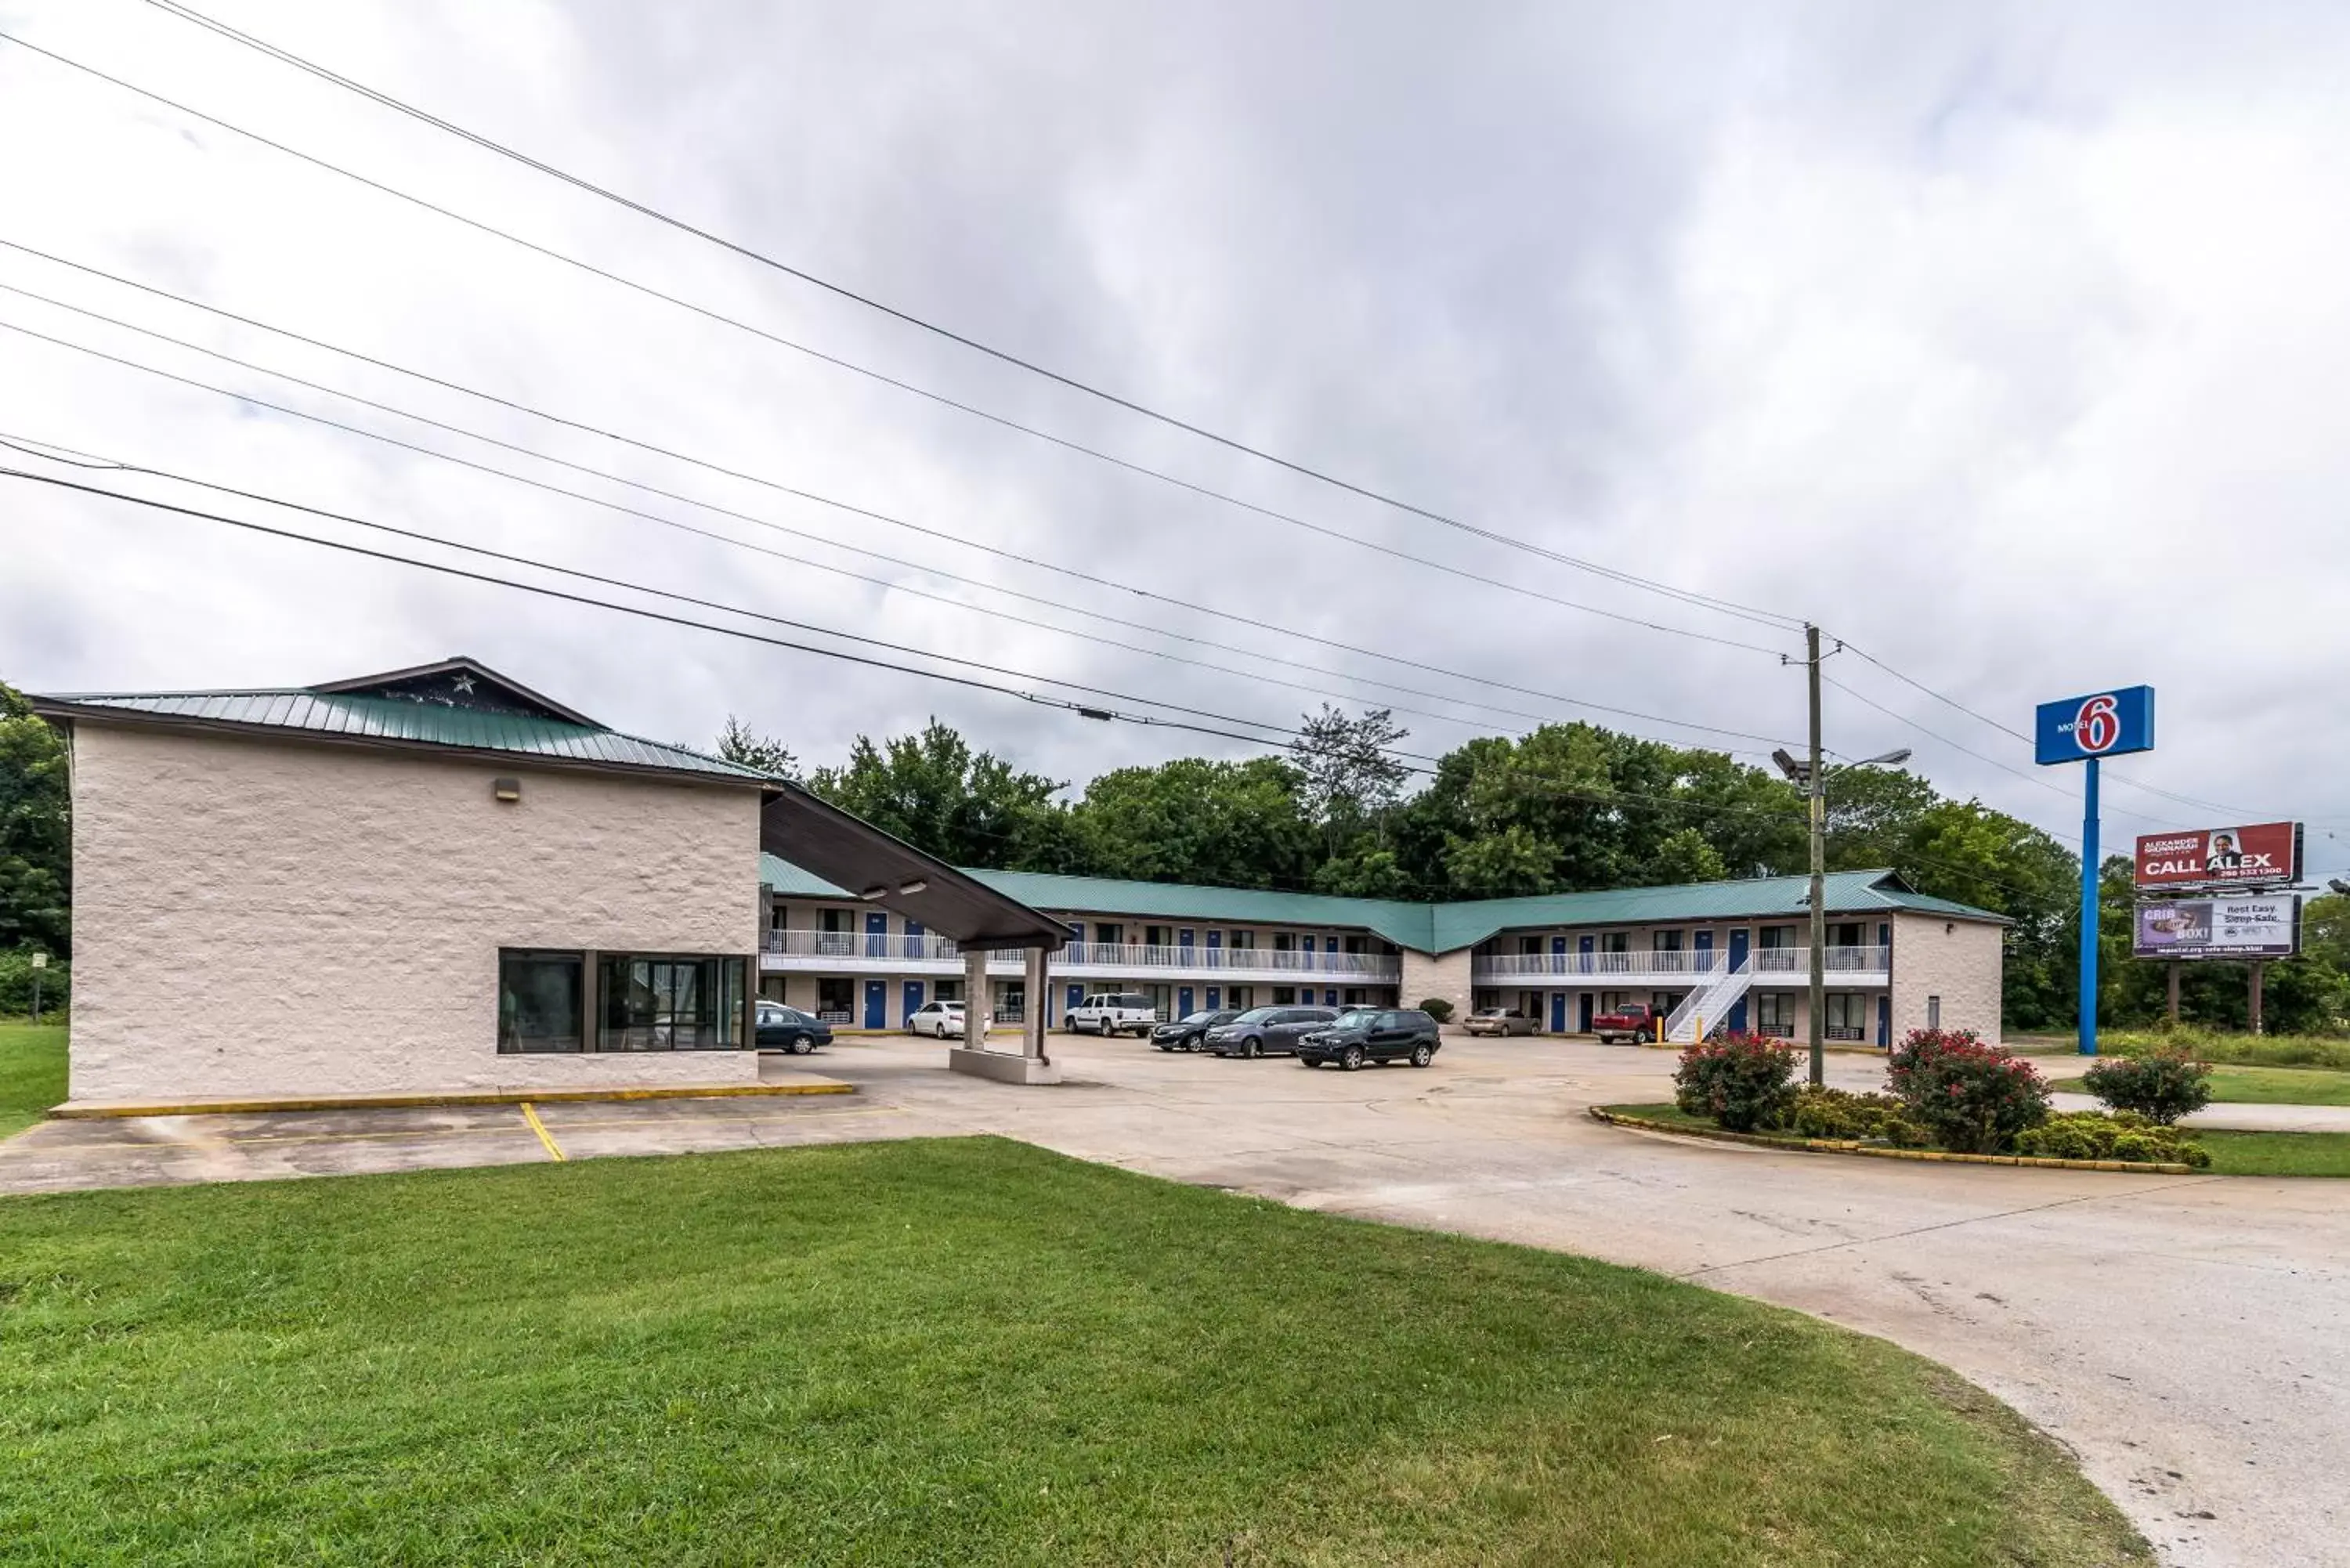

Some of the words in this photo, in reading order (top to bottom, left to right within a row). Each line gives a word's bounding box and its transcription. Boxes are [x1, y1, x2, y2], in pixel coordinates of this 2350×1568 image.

[2074, 694, 2120, 753] 6
[2145, 858, 2202, 875] CALL
[2207, 853, 2272, 871] ALEX
[2144, 909, 2175, 920] CRIB
[2227, 905, 2249, 914] Rest
